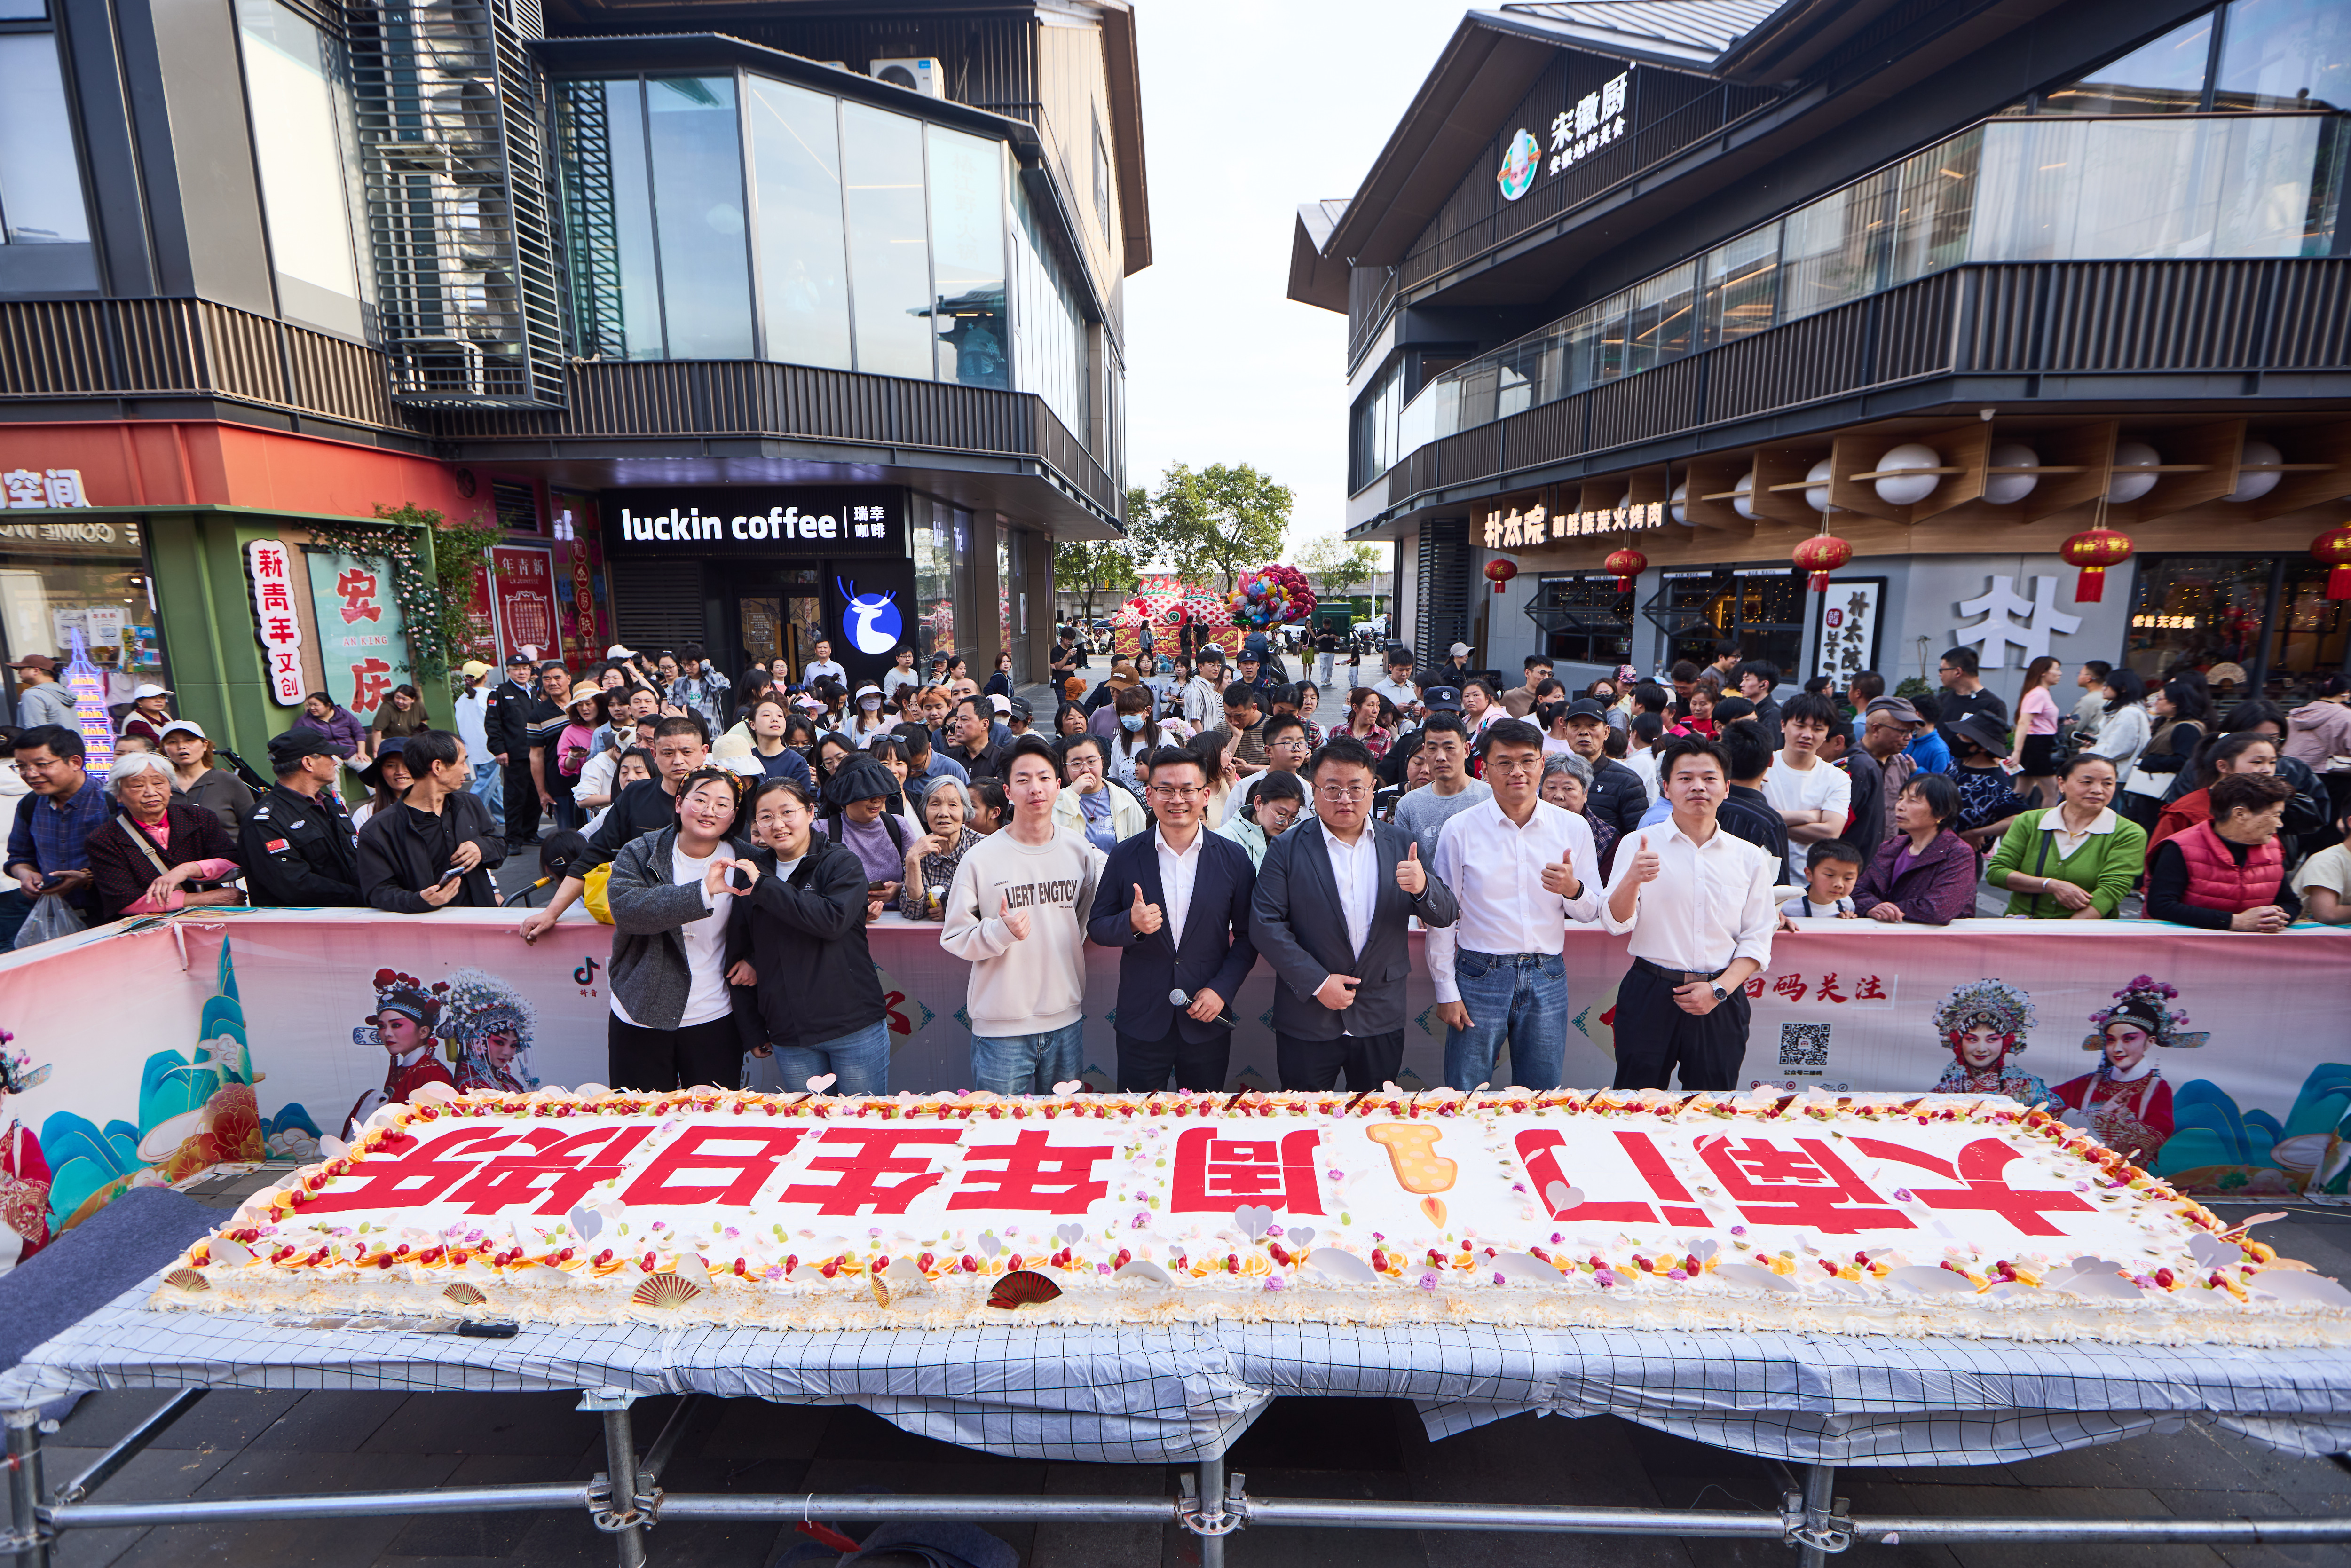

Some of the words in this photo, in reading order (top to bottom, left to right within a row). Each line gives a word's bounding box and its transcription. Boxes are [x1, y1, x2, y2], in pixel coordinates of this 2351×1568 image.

[1550, 71, 1628, 152] 宋徽厨
[0, 468, 86, 509] 空间
[622, 508, 723, 541] luckin
[732, 506, 836, 540] coffee
[853, 505, 884, 521] 瑞幸
[855, 522, 885, 538] 咖啡
[1484, 503, 1546, 549] 朴太院
[1552, 502, 1663, 538] 朝鲜族炭火烤肉
[258, 549, 299, 697] 新青年文创
[343, 637, 356, 646] AN
[361, 636, 388, 646] KING
[1005, 883, 1034, 909] LIERT
[579, 989, 598, 997] 抖音
